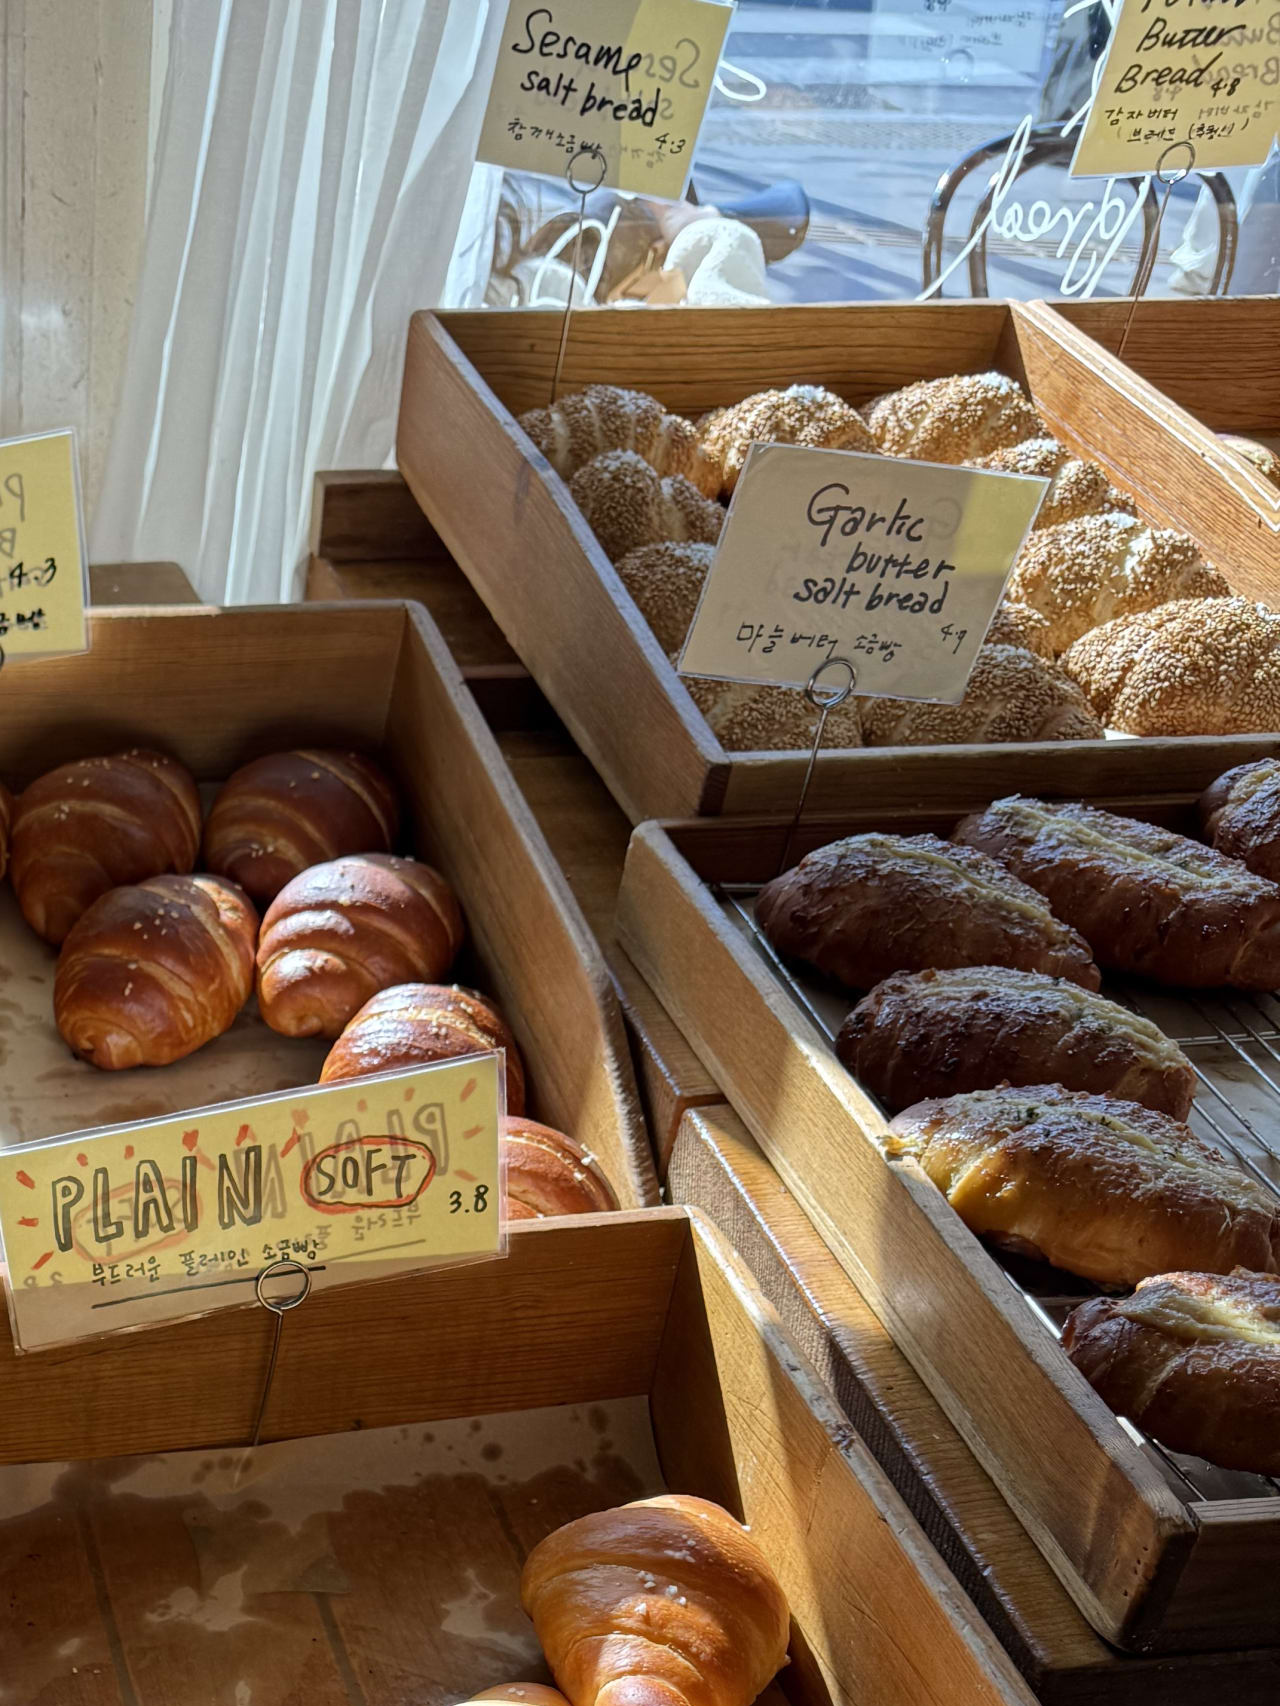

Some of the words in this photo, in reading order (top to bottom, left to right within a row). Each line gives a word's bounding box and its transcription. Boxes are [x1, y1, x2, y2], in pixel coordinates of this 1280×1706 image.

[511, 9, 642, 92] Sesame
[1136, 16, 1248, 53] Butter
[1114, 51, 1223, 94] Bread
[579, 82, 661, 128] bread
[654, 132, 687, 155] 4.3
[807, 483, 924, 548] Garlic
[9, 557, 57, 589] 4.3
[845, 542, 956, 580] butter
[869, 580, 949, 615] bread
[736, 622, 785, 654] 마늘
[853, 633, 903, 663] 소금빵
[51, 1144, 263, 1253] PLAIN
[316, 1149, 418, 1201] SOFT
[448, 1183, 490, 1215] 3.8
[92, 1256, 161, 1287] 부드러운
[179, 1246, 251, 1277] 플레인
[262, 1238, 322, 1263] 소금빵
